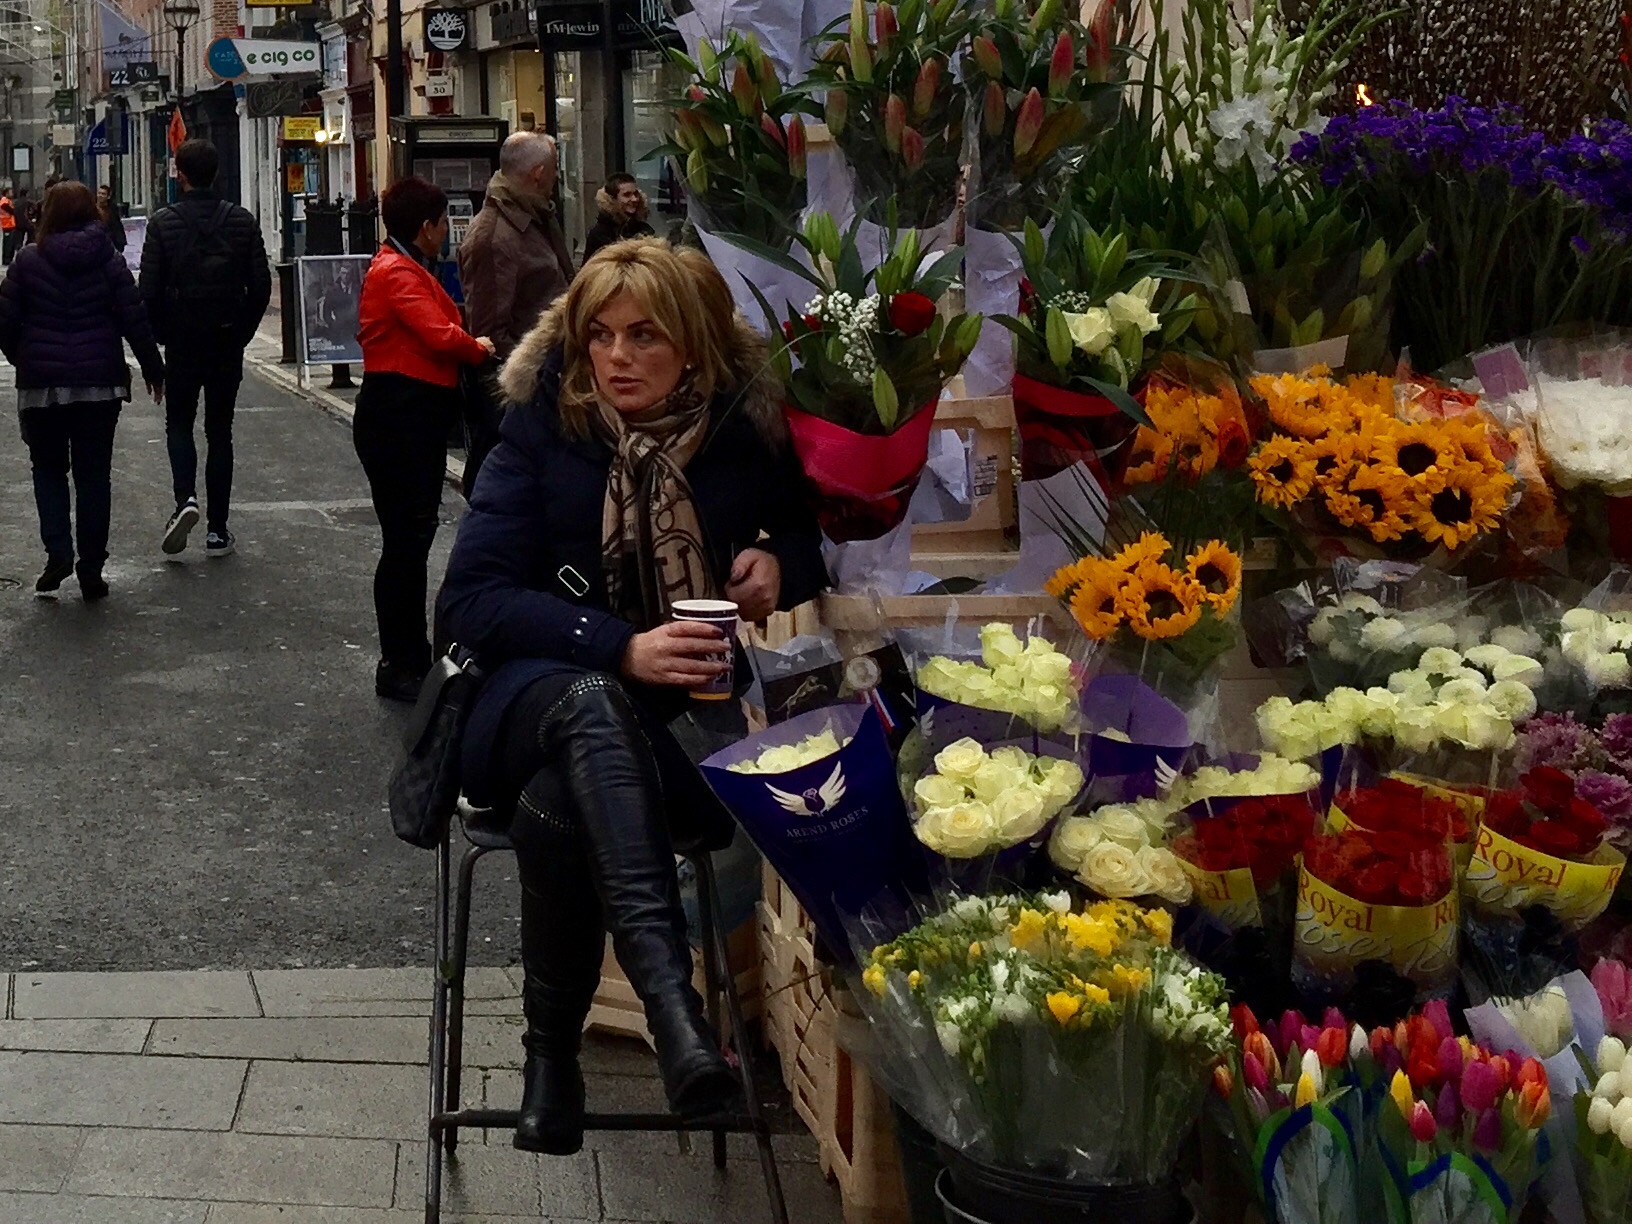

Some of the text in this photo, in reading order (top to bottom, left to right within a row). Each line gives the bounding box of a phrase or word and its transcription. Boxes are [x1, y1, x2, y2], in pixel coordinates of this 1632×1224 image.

[246, 53, 257, 65] e
[261, 51, 288, 66] cig
[292, 49, 315, 62] co
[786, 805, 869, 838] AREND ROSES
[1473, 826, 1568, 889] Royal
[1297, 873, 1374, 933] Royal
